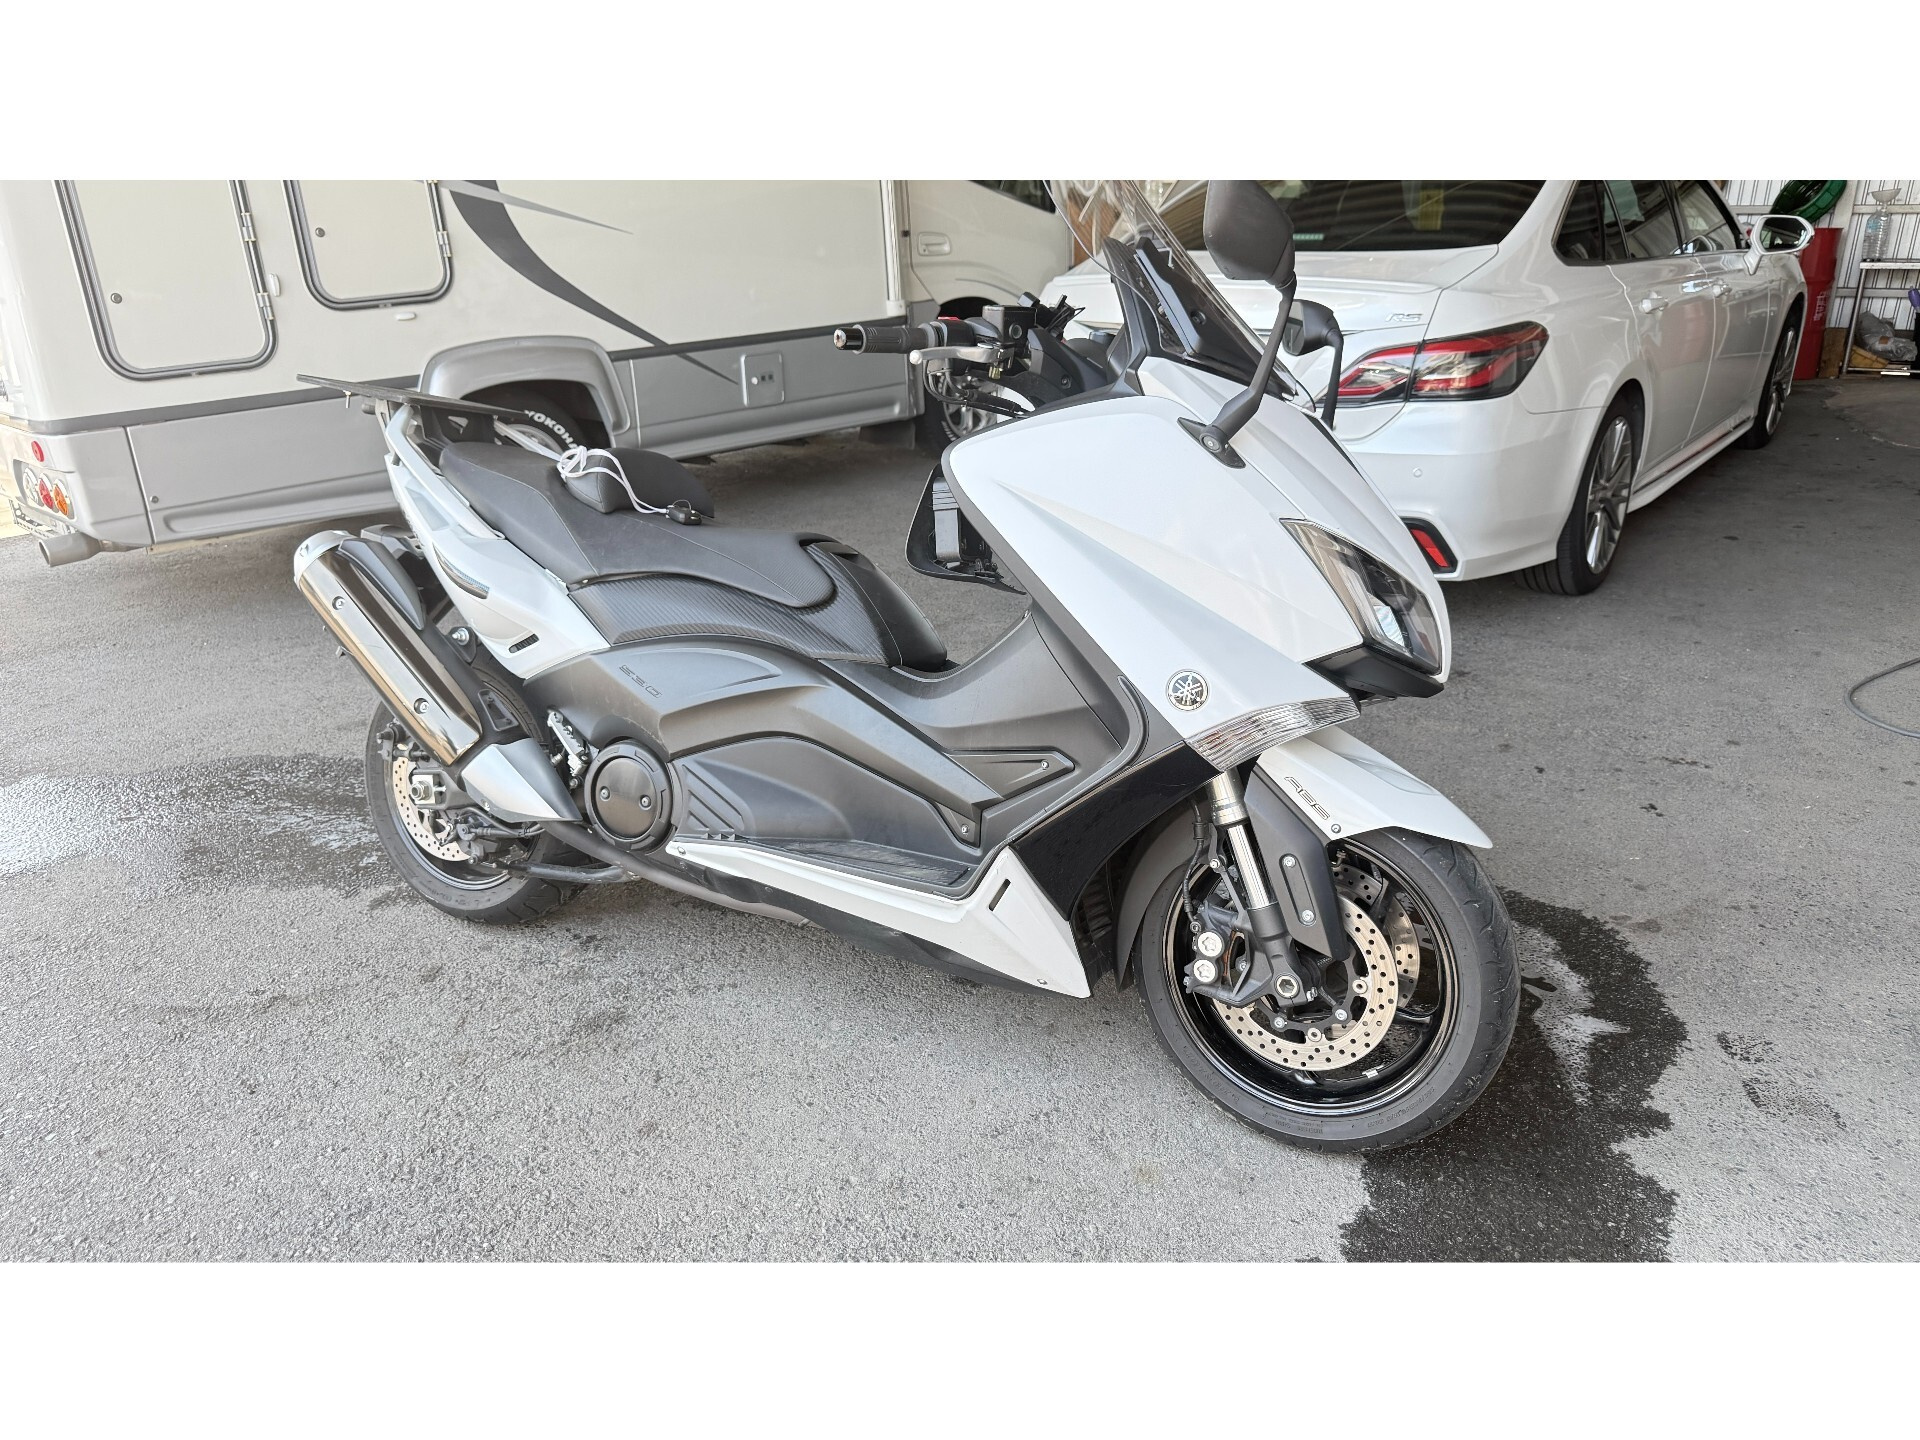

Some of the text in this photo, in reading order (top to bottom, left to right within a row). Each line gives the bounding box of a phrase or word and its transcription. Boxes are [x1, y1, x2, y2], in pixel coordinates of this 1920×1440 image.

[1384, 312, 1422, 323] RS
[618, 664, 662, 699] 530
[1283, 776, 1331, 821] ABS
